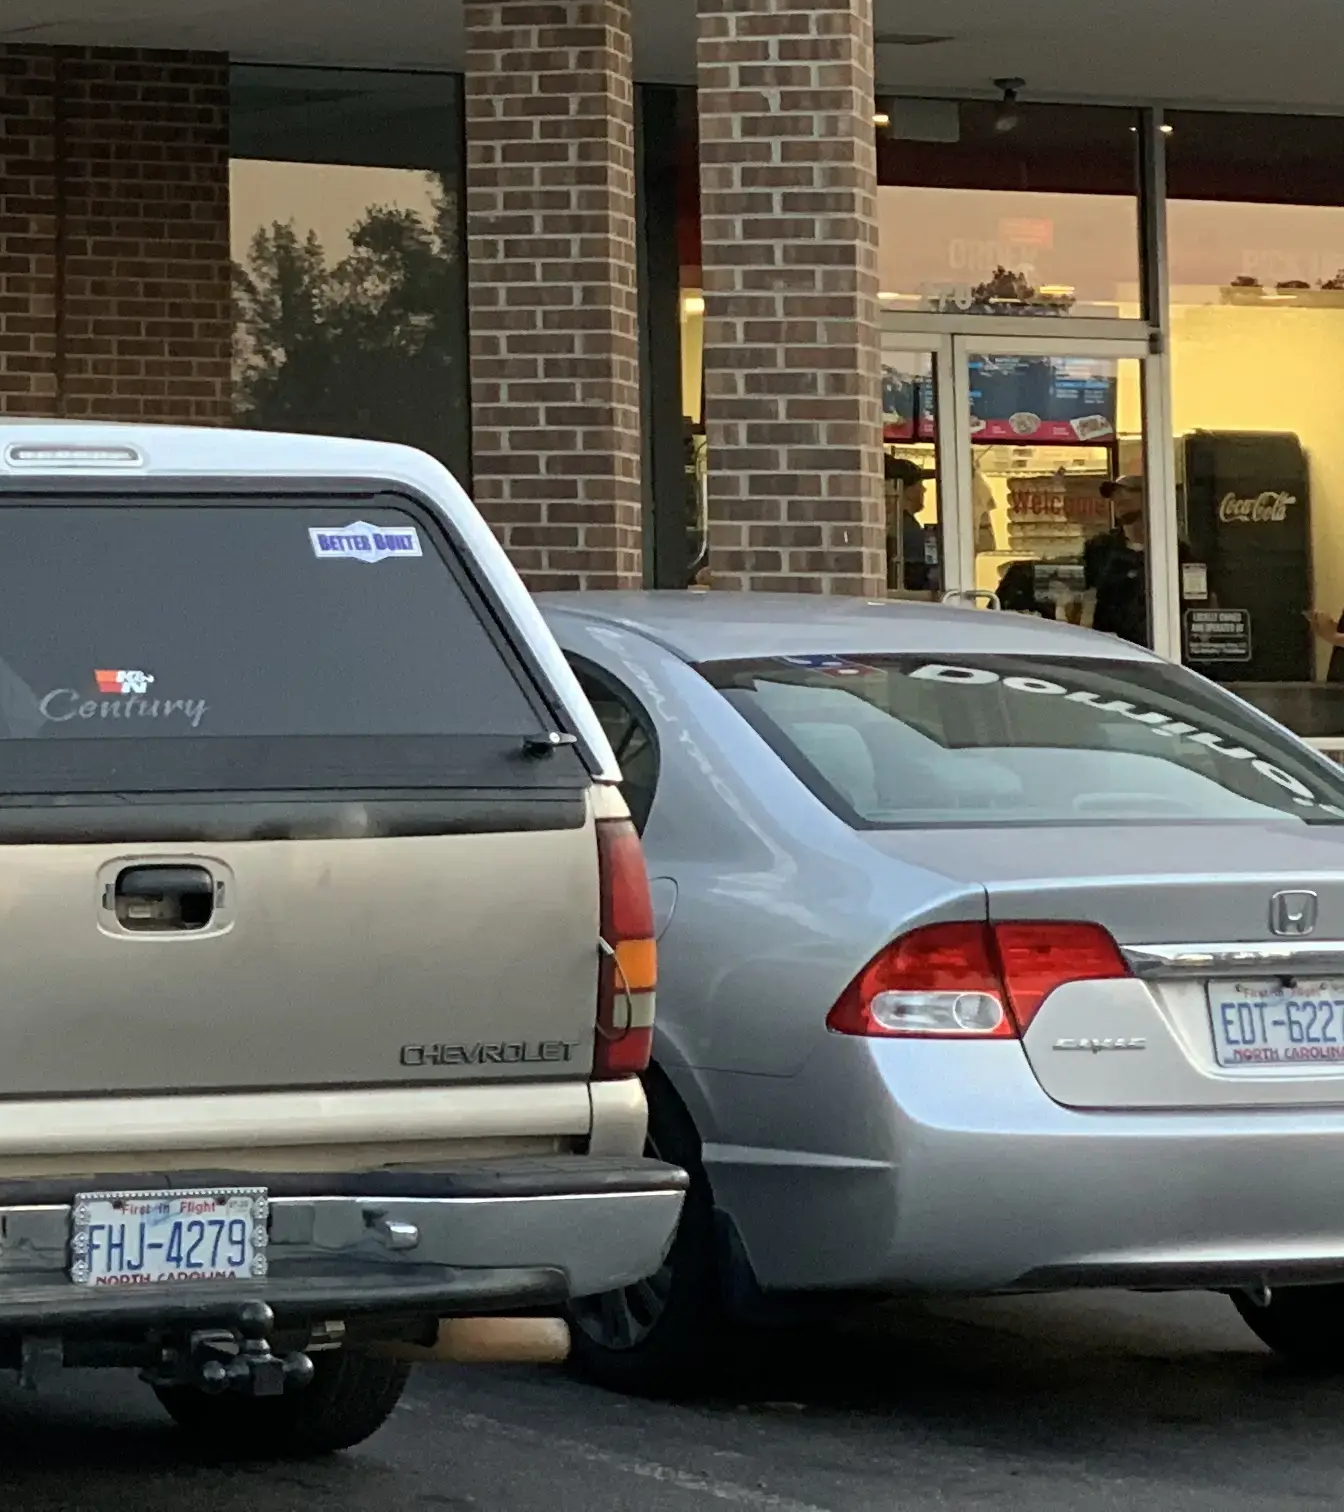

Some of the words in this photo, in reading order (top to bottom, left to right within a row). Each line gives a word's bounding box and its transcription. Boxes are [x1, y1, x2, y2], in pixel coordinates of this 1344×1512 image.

[317, 533, 372, 551] BETTER
[372, 533, 413, 551] BUILT
[39, 688, 209, 727] Century
[400, 1041, 580, 1065] CHEVROLET
[1233, 1048, 1279, 1061] NORTH
[122, 1205, 150, 1215] First
[180, 1201, 216, 1215] Flight
[87, 1219, 246, 1273] FHJ-4279
[96, 1274, 151, 1285] NORTH
